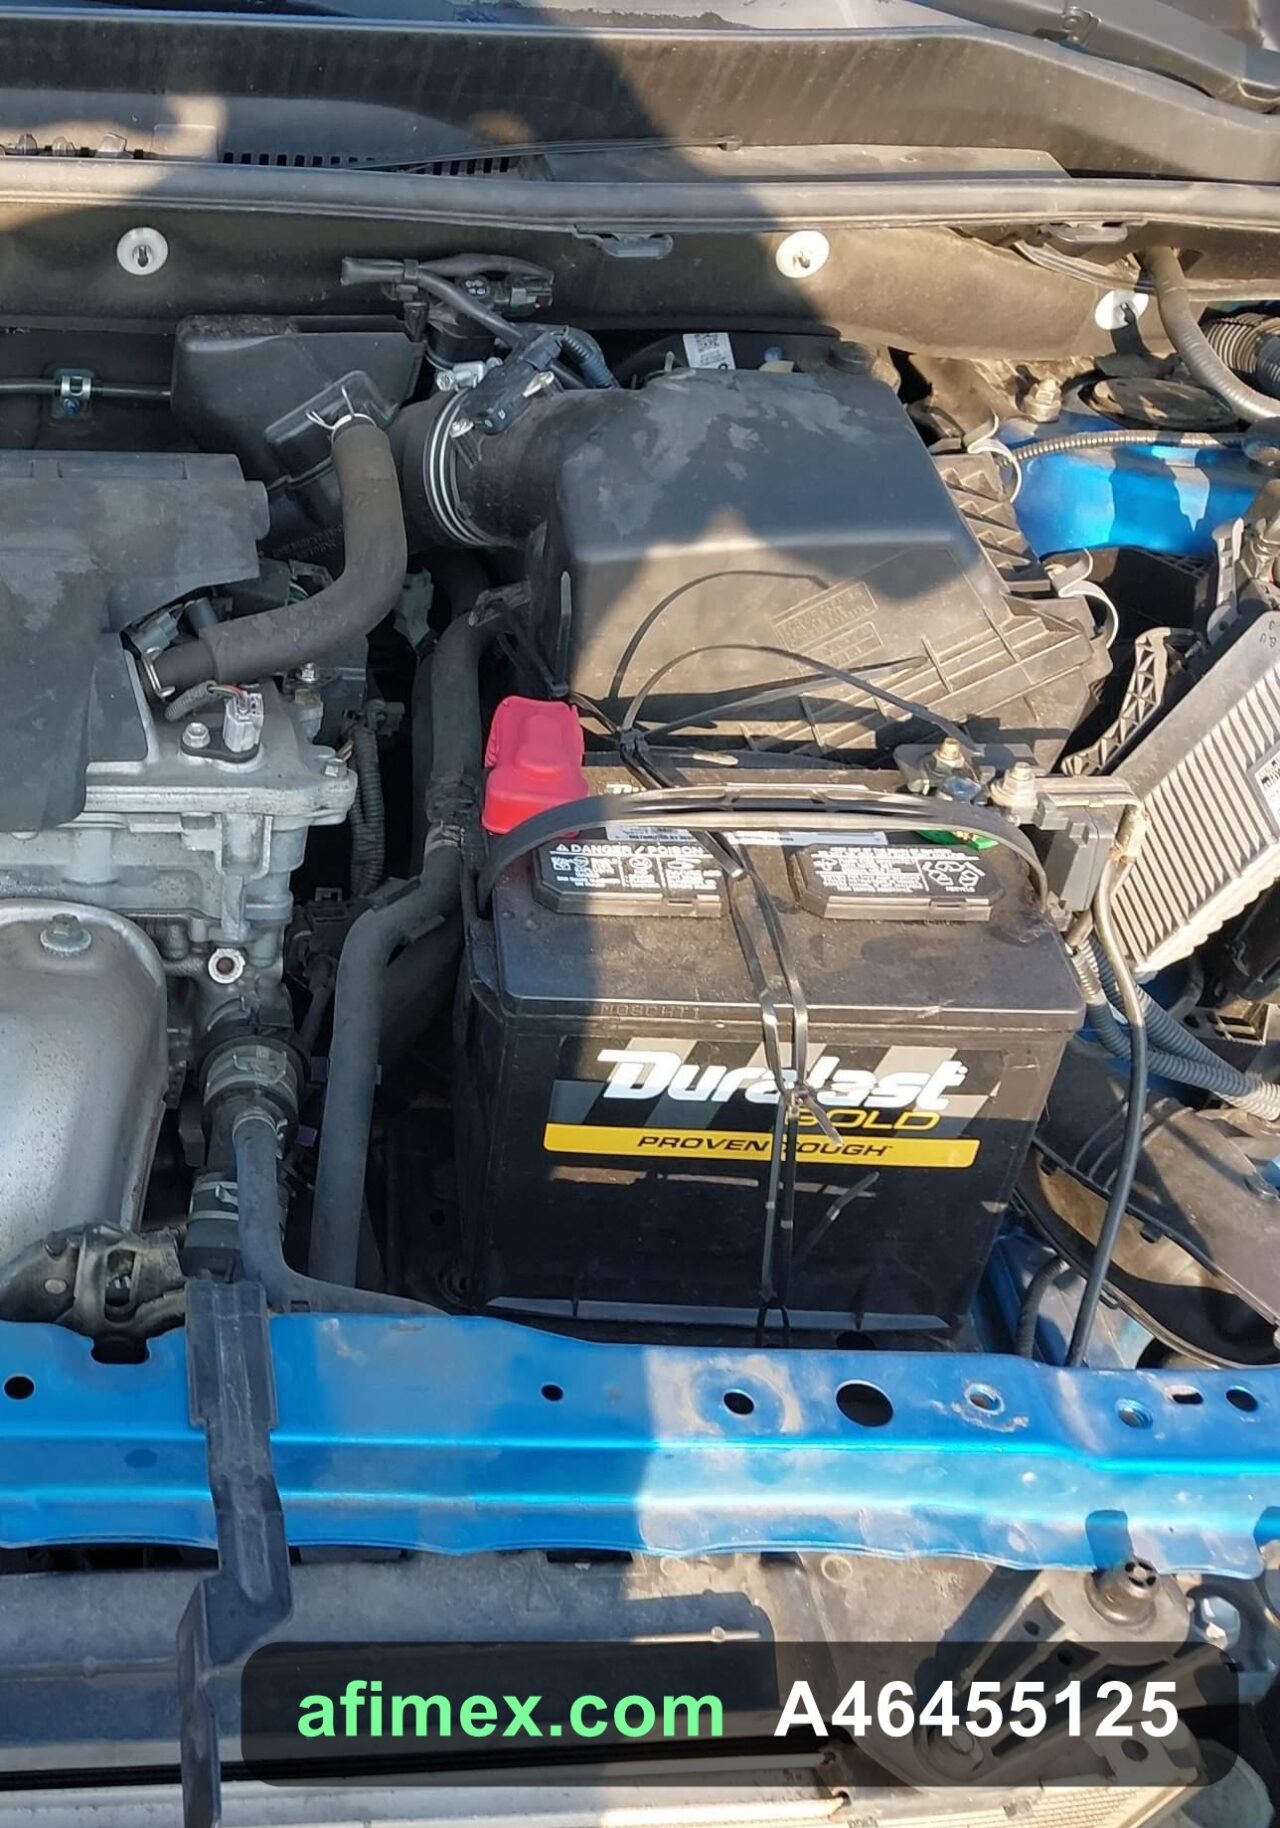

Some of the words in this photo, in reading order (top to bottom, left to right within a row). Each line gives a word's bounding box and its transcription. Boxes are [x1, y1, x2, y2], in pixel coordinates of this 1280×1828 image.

[571, 844, 632, 855] DANGER
[597, 1049, 962, 1110] Duralast
[637, 1136, 770, 1152] PROVEN
[783, 1141, 887, 1157] OUGH
